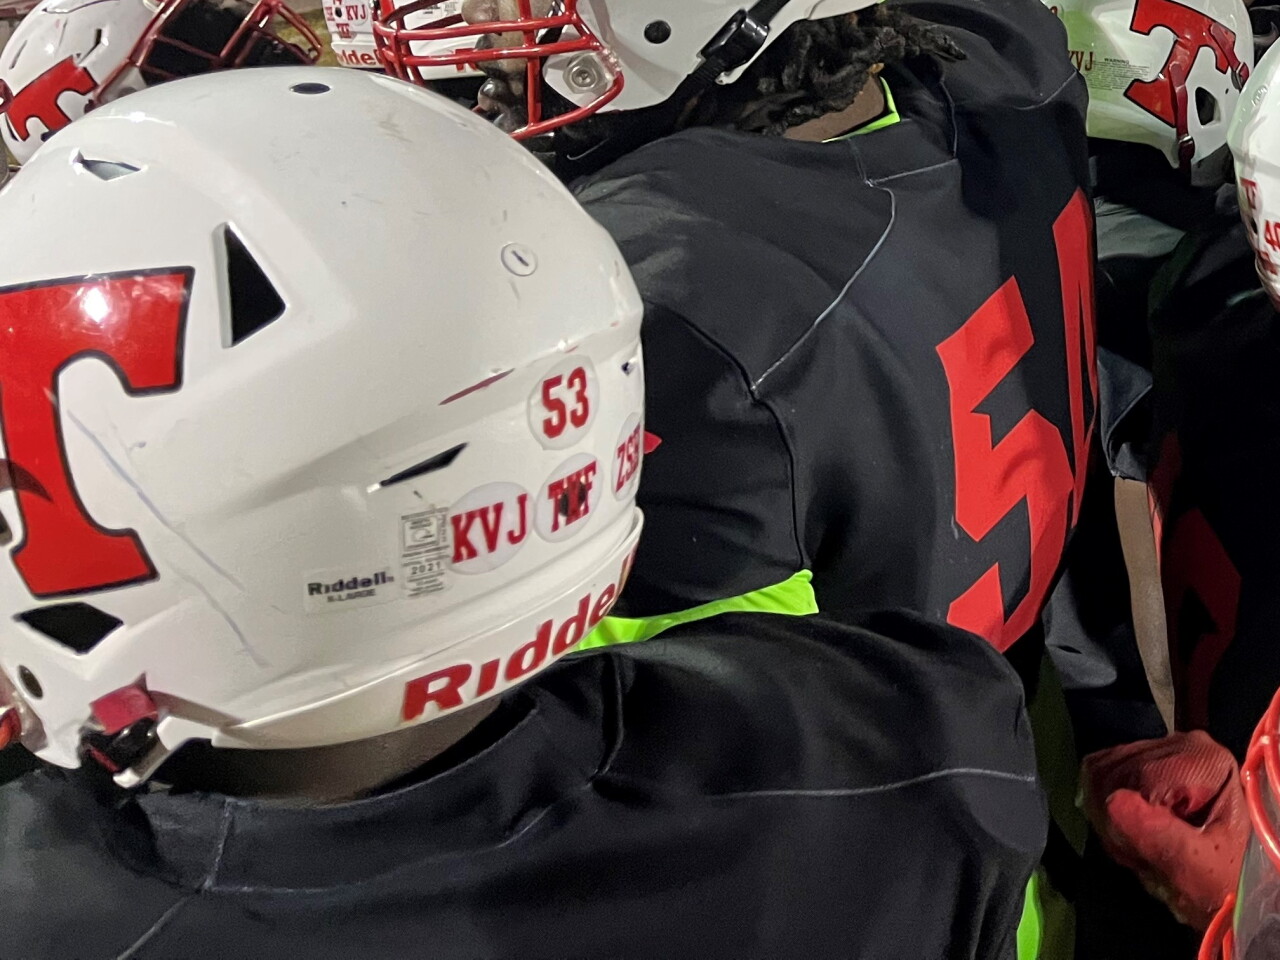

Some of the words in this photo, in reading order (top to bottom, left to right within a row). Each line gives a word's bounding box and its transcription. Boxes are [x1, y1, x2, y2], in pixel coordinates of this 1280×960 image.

[345, 3, 367, 21] KVJ
[541, 366, 589, 439] 53
[0, 266, 195, 600] T
[451, 493, 528, 564] KVJ
[308, 571, 388, 596] Riddell
[411, 561, 441, 575] 2021
